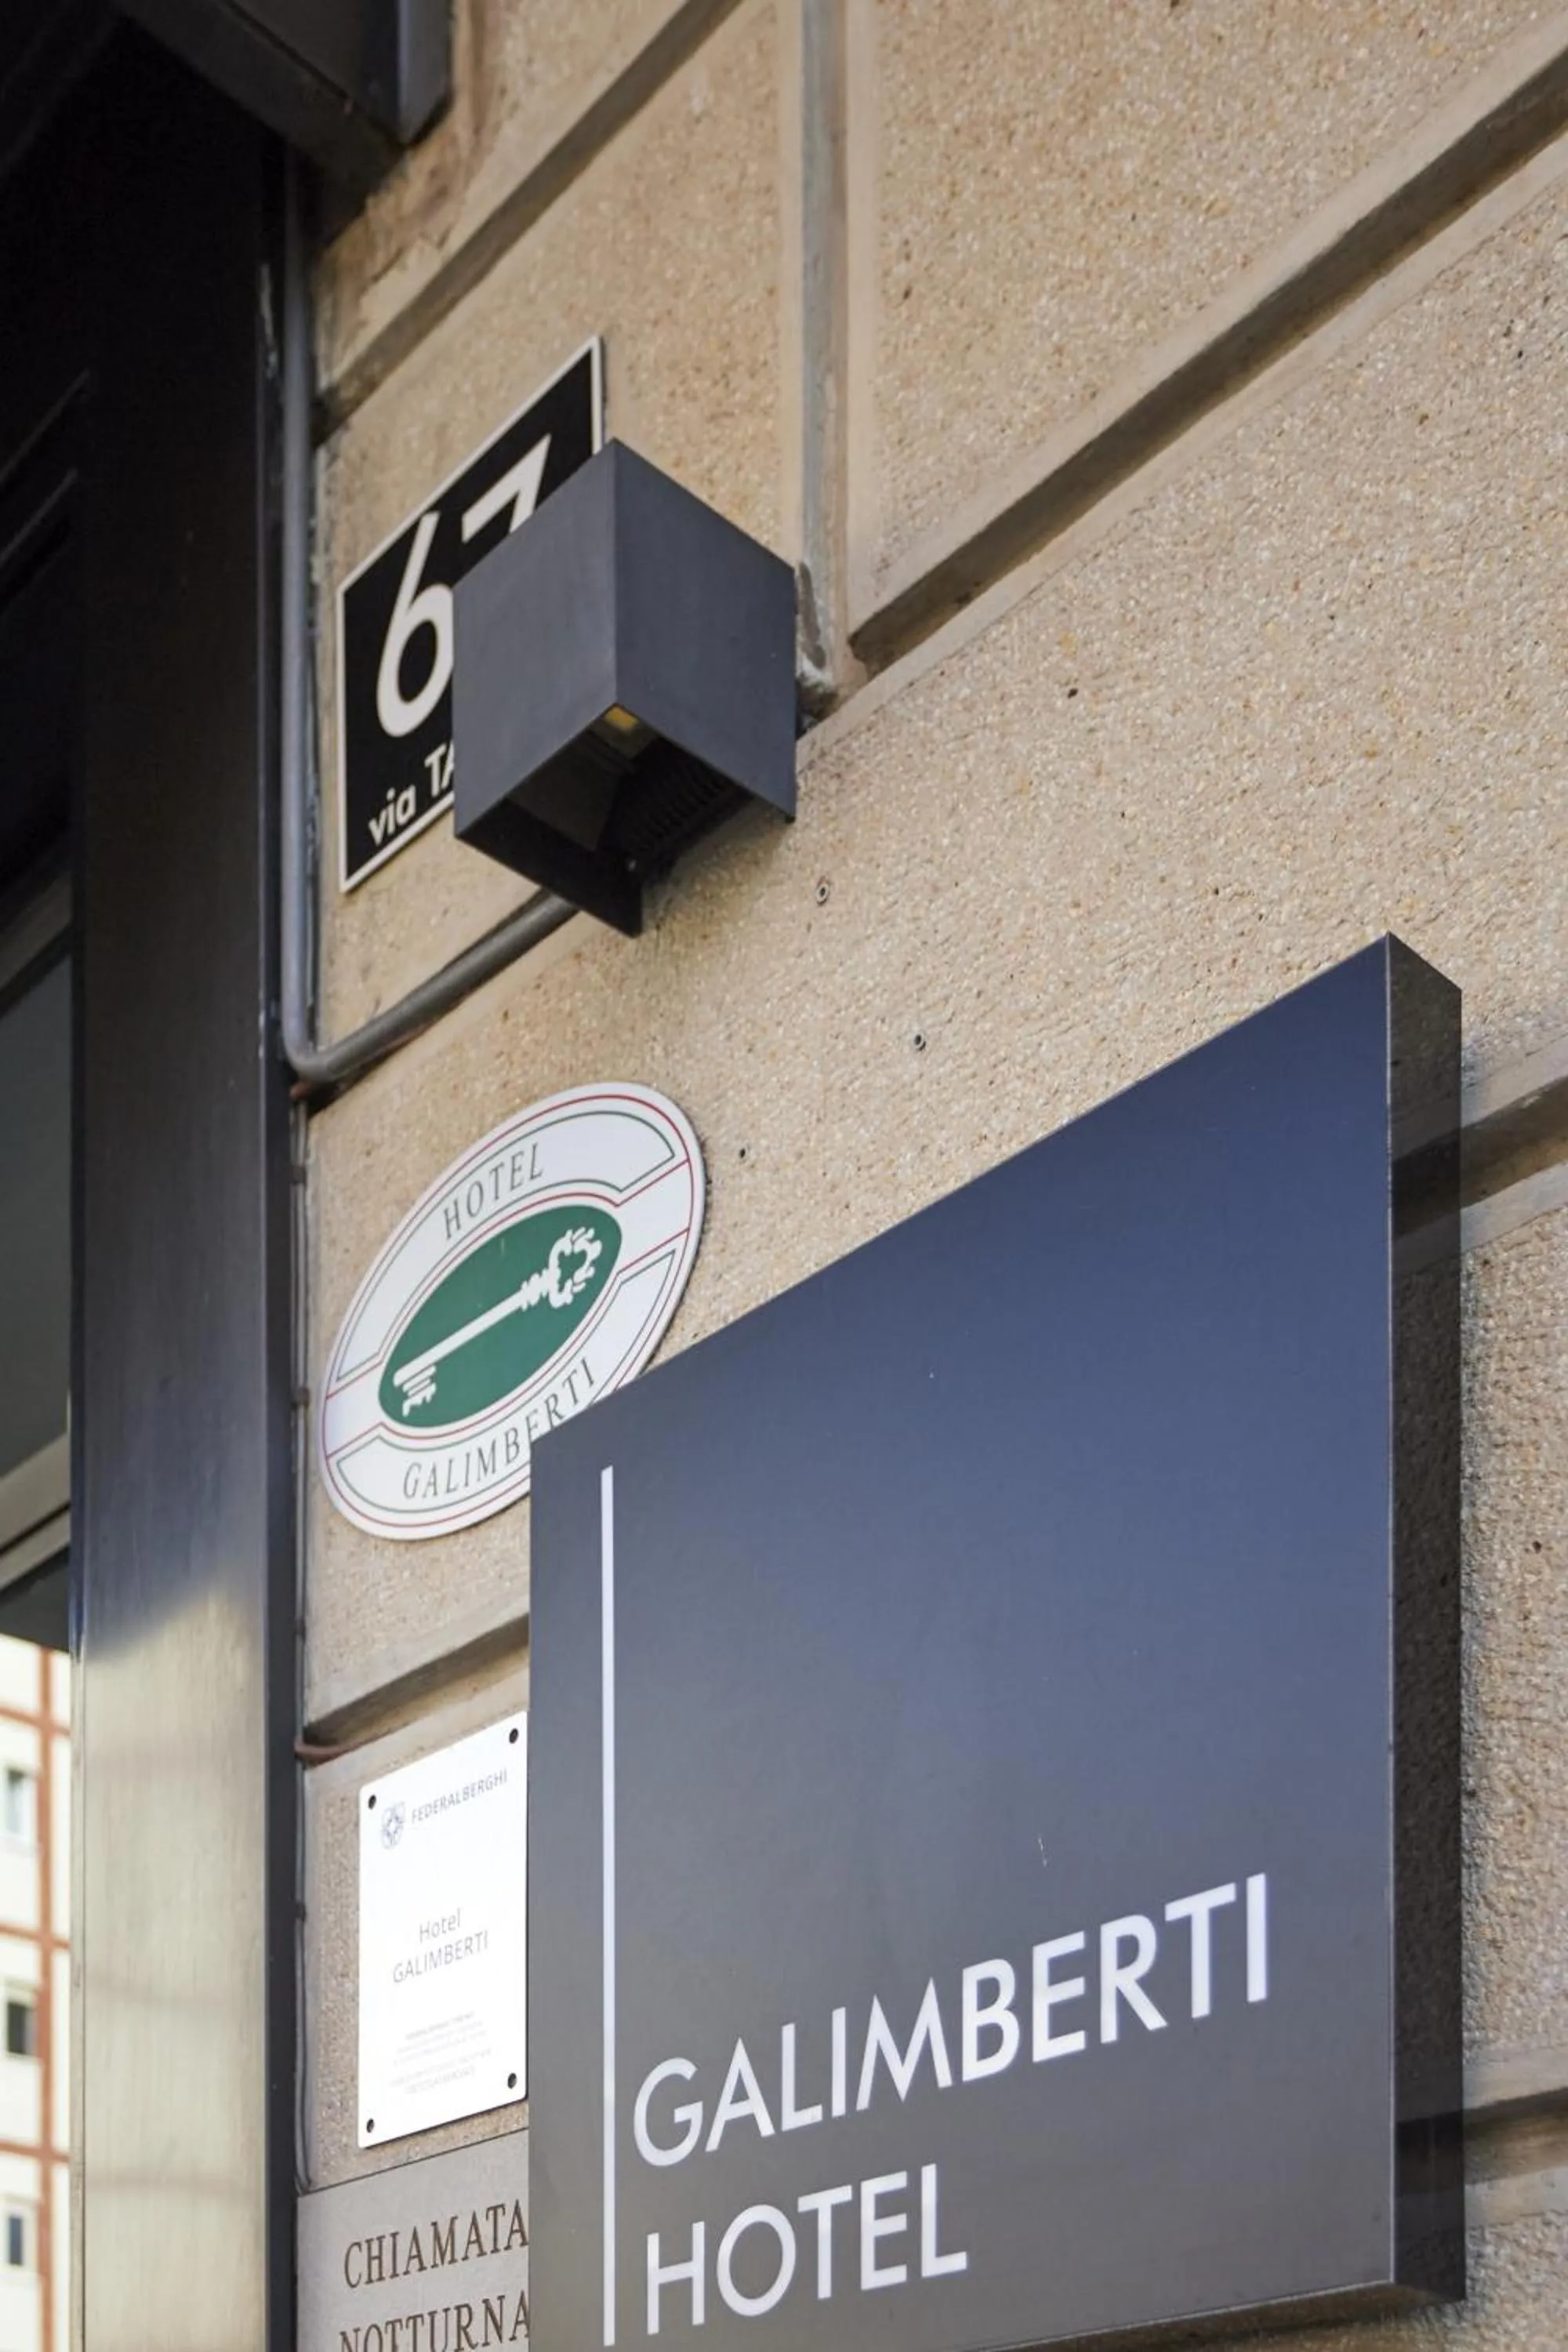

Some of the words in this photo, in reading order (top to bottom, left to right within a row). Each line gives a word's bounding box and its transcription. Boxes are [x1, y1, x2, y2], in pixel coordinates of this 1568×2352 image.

[368, 784, 416, 847] via
[442, 1142, 543, 1240] HOTEL
[402, 1358, 594, 1500] GALIMBERTI
[412, 1768, 507, 1824] FEDERALBERGHI
[393, 1929, 488, 1983] GALIMBERTI
[419, 1907, 460, 1944] Hotel
[633, 1873, 1268, 2167] GALIMBERTI
[343, 2198, 529, 2288] CHIAMATA
[647, 2164, 967, 2336] HOTEL
